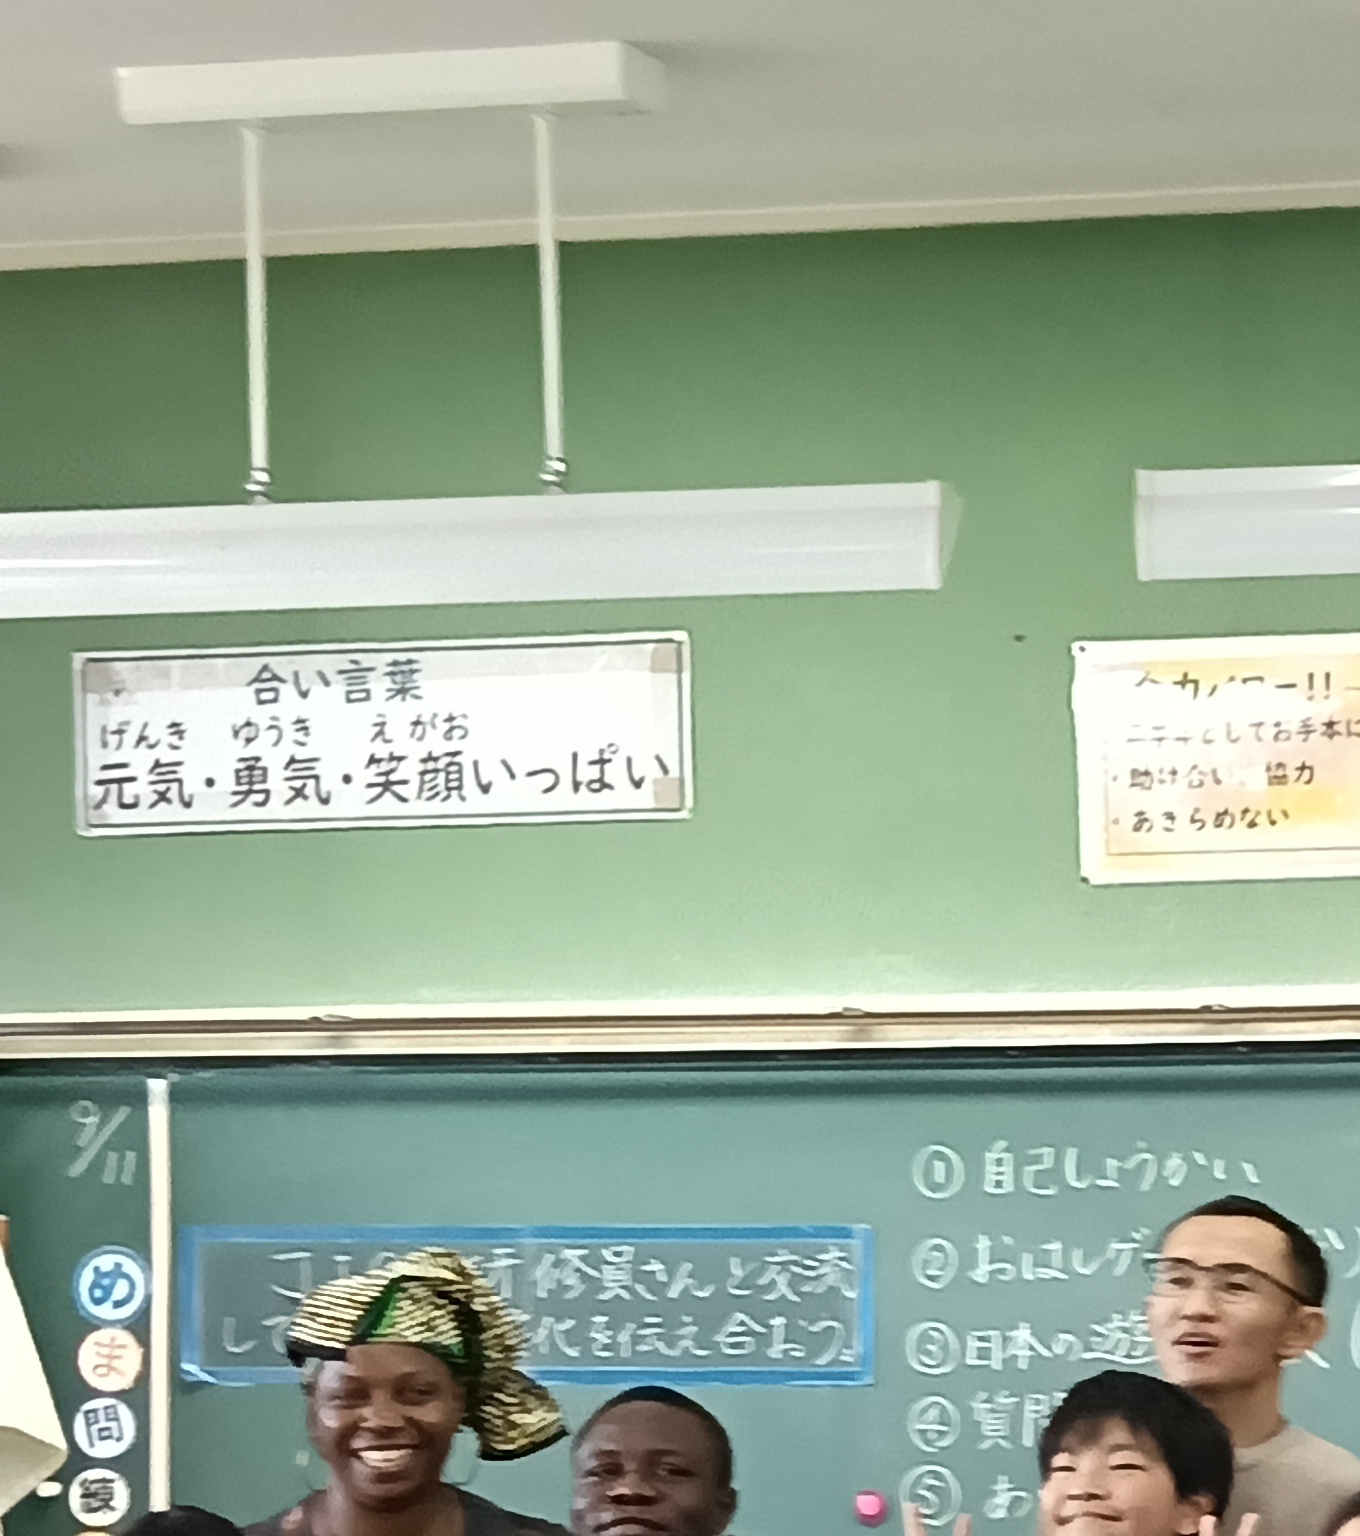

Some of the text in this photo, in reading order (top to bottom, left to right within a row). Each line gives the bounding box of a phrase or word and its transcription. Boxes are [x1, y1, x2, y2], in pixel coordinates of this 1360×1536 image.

[245, 659, 425, 705] 合い言葉
[101, 719, 187, 750] げんき
[231, 715, 312, 747] ゆうき
[92, 742, 669, 811] 元気・勇気・笑顔いっぱい
[67, 1099, 137, 1185] 9/11
